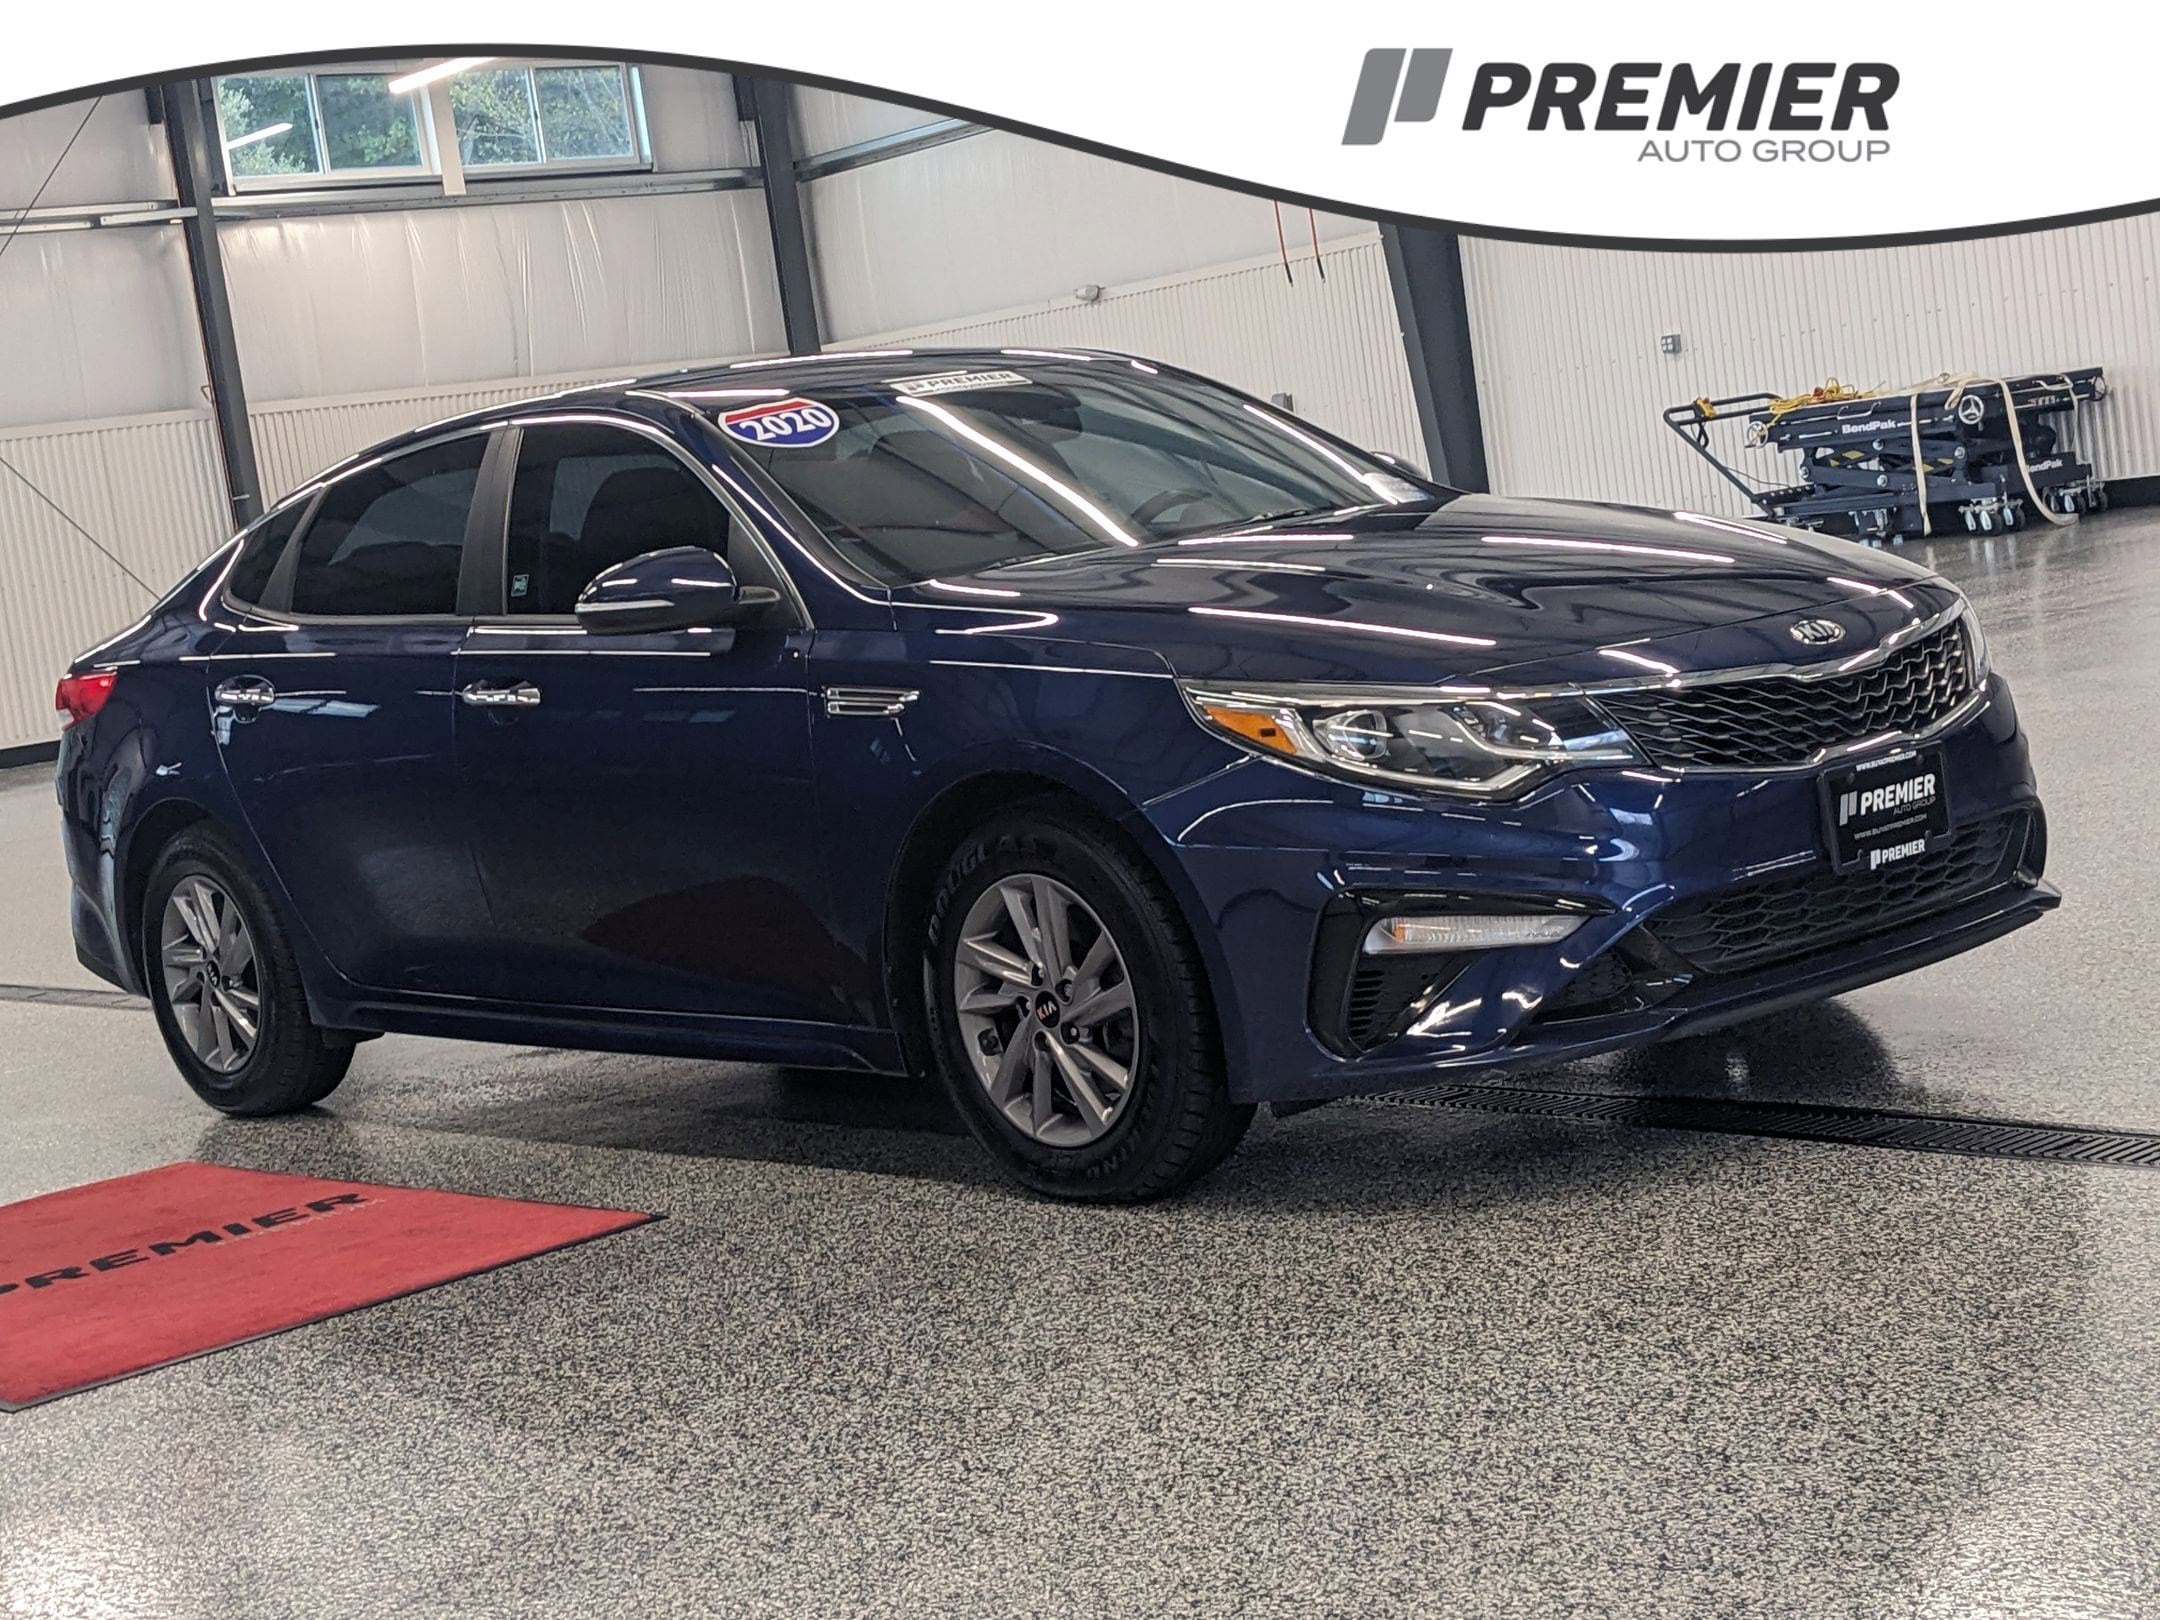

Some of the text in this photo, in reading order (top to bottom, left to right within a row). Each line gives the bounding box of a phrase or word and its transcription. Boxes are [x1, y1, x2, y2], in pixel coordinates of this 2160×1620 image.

[926, 372, 1012, 389] PREMIER
[739, 408, 831, 441] 2020
[1841, 418, 1897, 435] BendPak
[1860, 773, 1936, 815] PREMIER
[1893, 796, 1936, 815] AUTO GROUP
[1881, 838, 1926, 864] PREMIER
[1036, 1001, 1058, 1021] KIA
